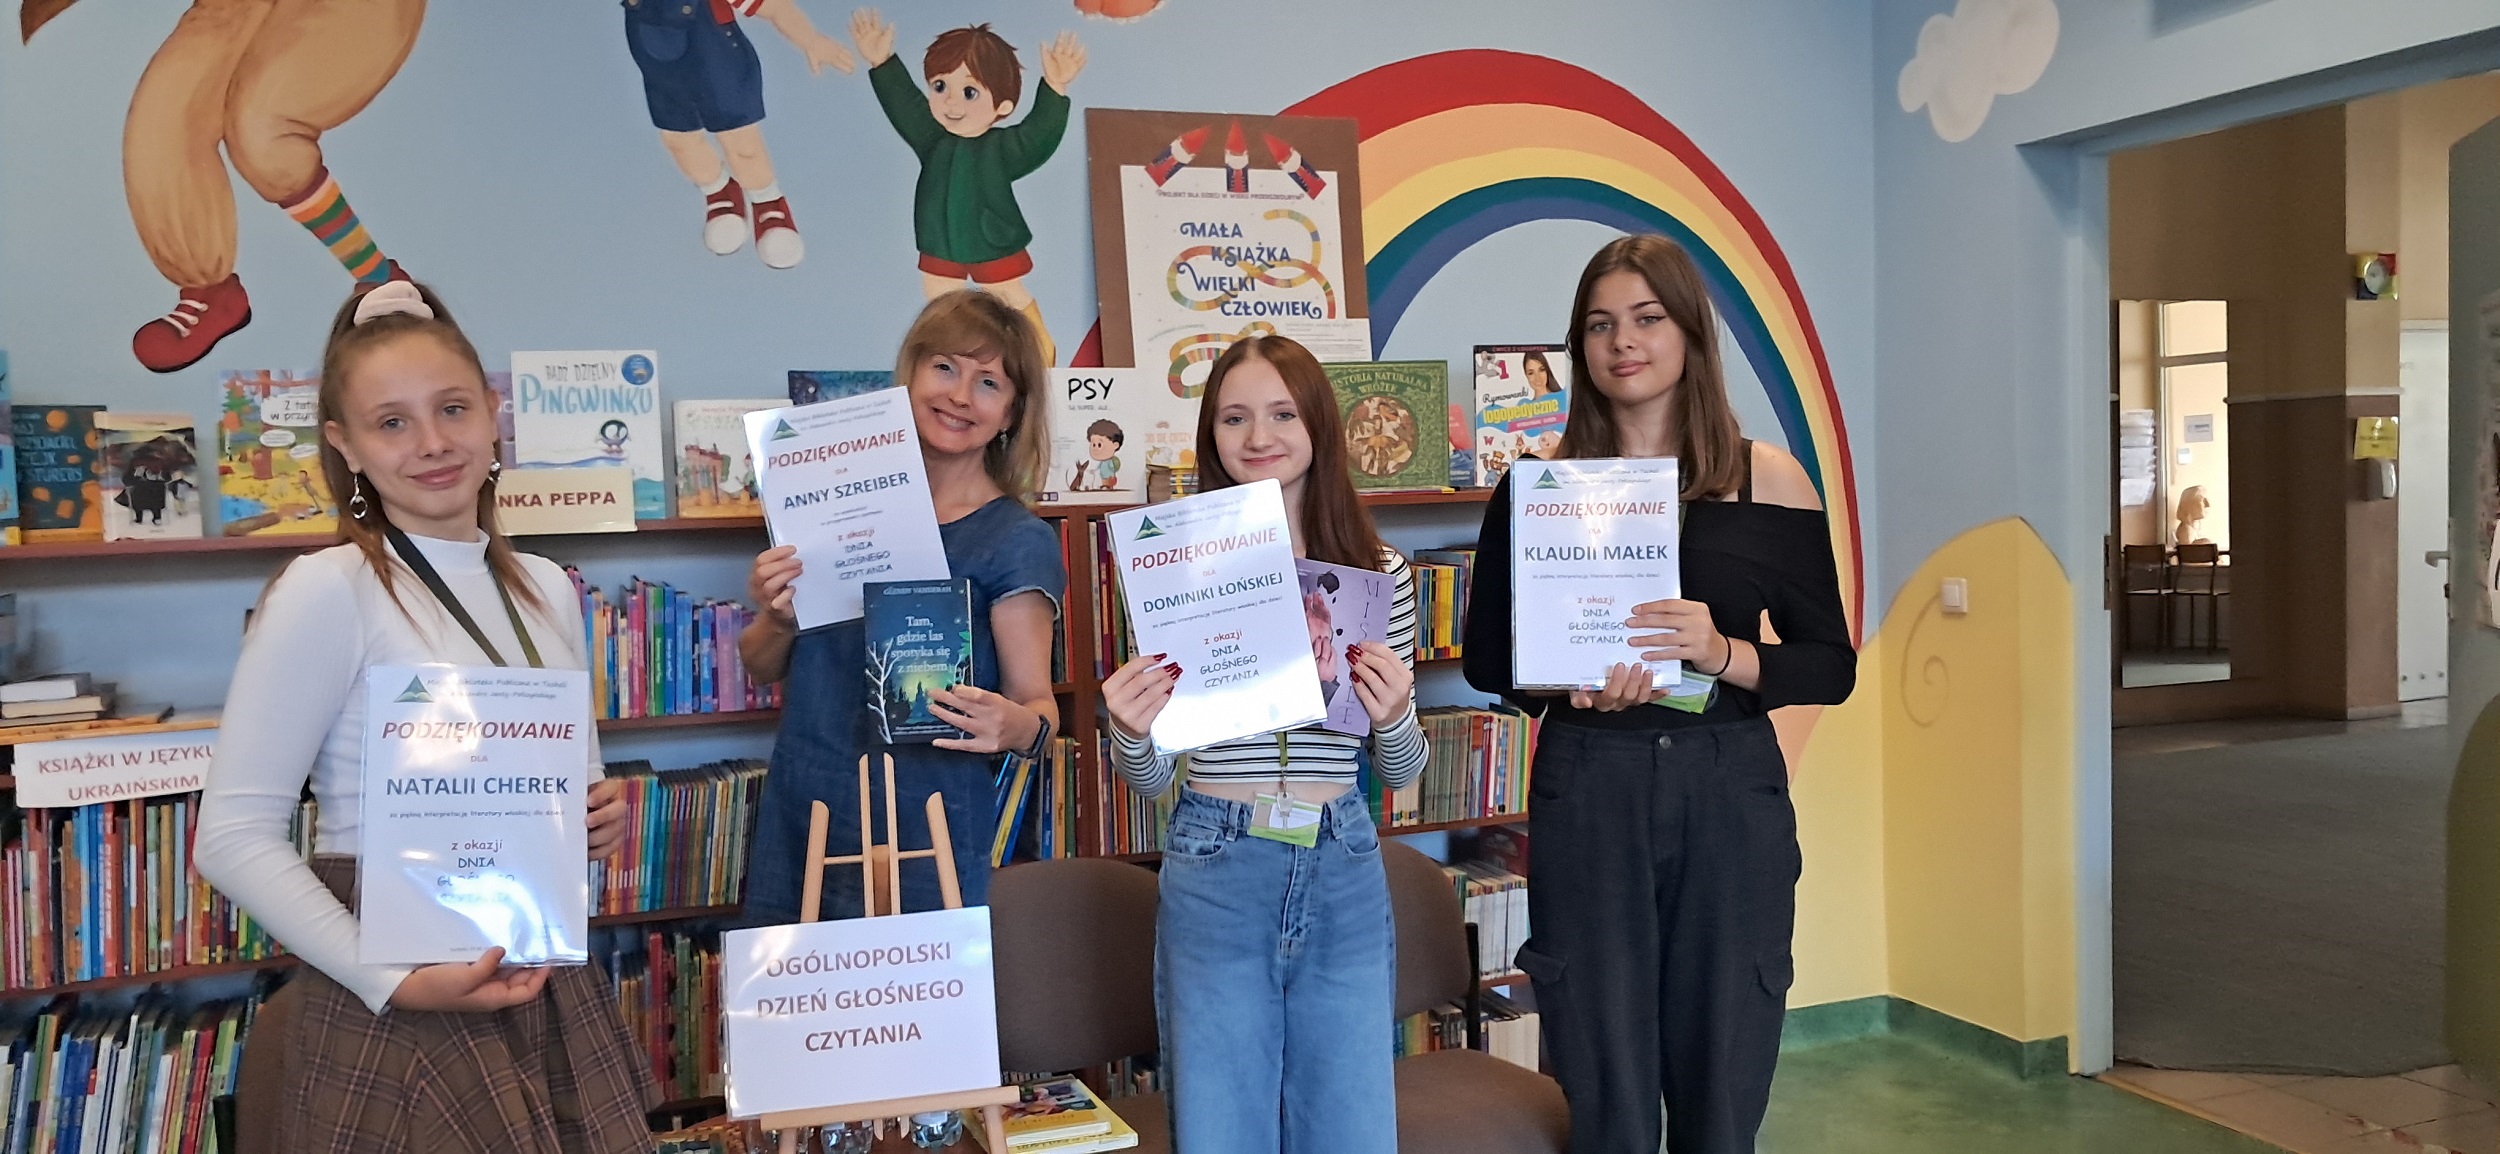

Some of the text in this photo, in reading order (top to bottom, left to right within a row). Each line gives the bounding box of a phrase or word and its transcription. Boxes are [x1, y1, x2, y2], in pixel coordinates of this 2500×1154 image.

[1180, 222, 1243, 238] MAŁA
[1211, 242, 1291, 268] KSIĄŻKA
[1177, 262, 1256, 298] WIELKI
[1220, 301, 1322, 319] CZŁOWIEK
[519, 373, 653, 415] PINGWINKU
[1068, 377, 1114, 400] PSY
[1482, 387, 1529, 407] Rymowanki
[1483, 399, 1559, 424] logopedyczne
[768, 429, 906, 470] PODZIĘKOWANIE
[550, 491, 617, 506] PEPPA
[784, 472, 910, 510] ANNY SZREIBER
[1525, 502, 1667, 520] PODZIĘKOWANIE
[1131, 527, 1278, 572] PODZIĘKOWANIE
[1525, 545, 1668, 561] KLAUDII MAŁEK
[1143, 571, 1283, 614] DOMINIKI ŁOŃSKIEJ
[1587, 595, 1615, 606] okazji
[905, 616, 934, 628] Tam,
[1583, 609, 1610, 618] DNIA
[1568, 618, 1625, 630] GŁOŚNEGO
[896, 630, 944, 646] gdzie las
[1203, 628, 1244, 645] z okazji
[1570, 635, 1624, 644] CZYTANIA
[891, 645, 951, 660] spotyka się
[1211, 644, 1241, 658] DNIA
[897, 660, 948, 674] z niebem
[1199, 653, 1259, 675] GŁOŚNEGO
[1204, 668, 1260, 689] CZYTANIA
[382, 721, 576, 743] PODZIĘKOWANIE
[39, 752, 115, 774] KSIĄŻKI
[122, 751, 143, 766] W
[470, 755, 488, 763] DLA
[68, 775, 199, 801] UKRAIŃSKIM
[386, 777, 569, 796] NATALII CHEREK
[451, 839, 503, 853] z okazji
[458, 857, 495, 868] DNIA
[766, 941, 951, 978] OGÓLNOPOLSKI
[757, 977, 964, 1018] DZIEŃ GŁOŚNEGO
[805, 1022, 922, 1052] CZYTANIA
